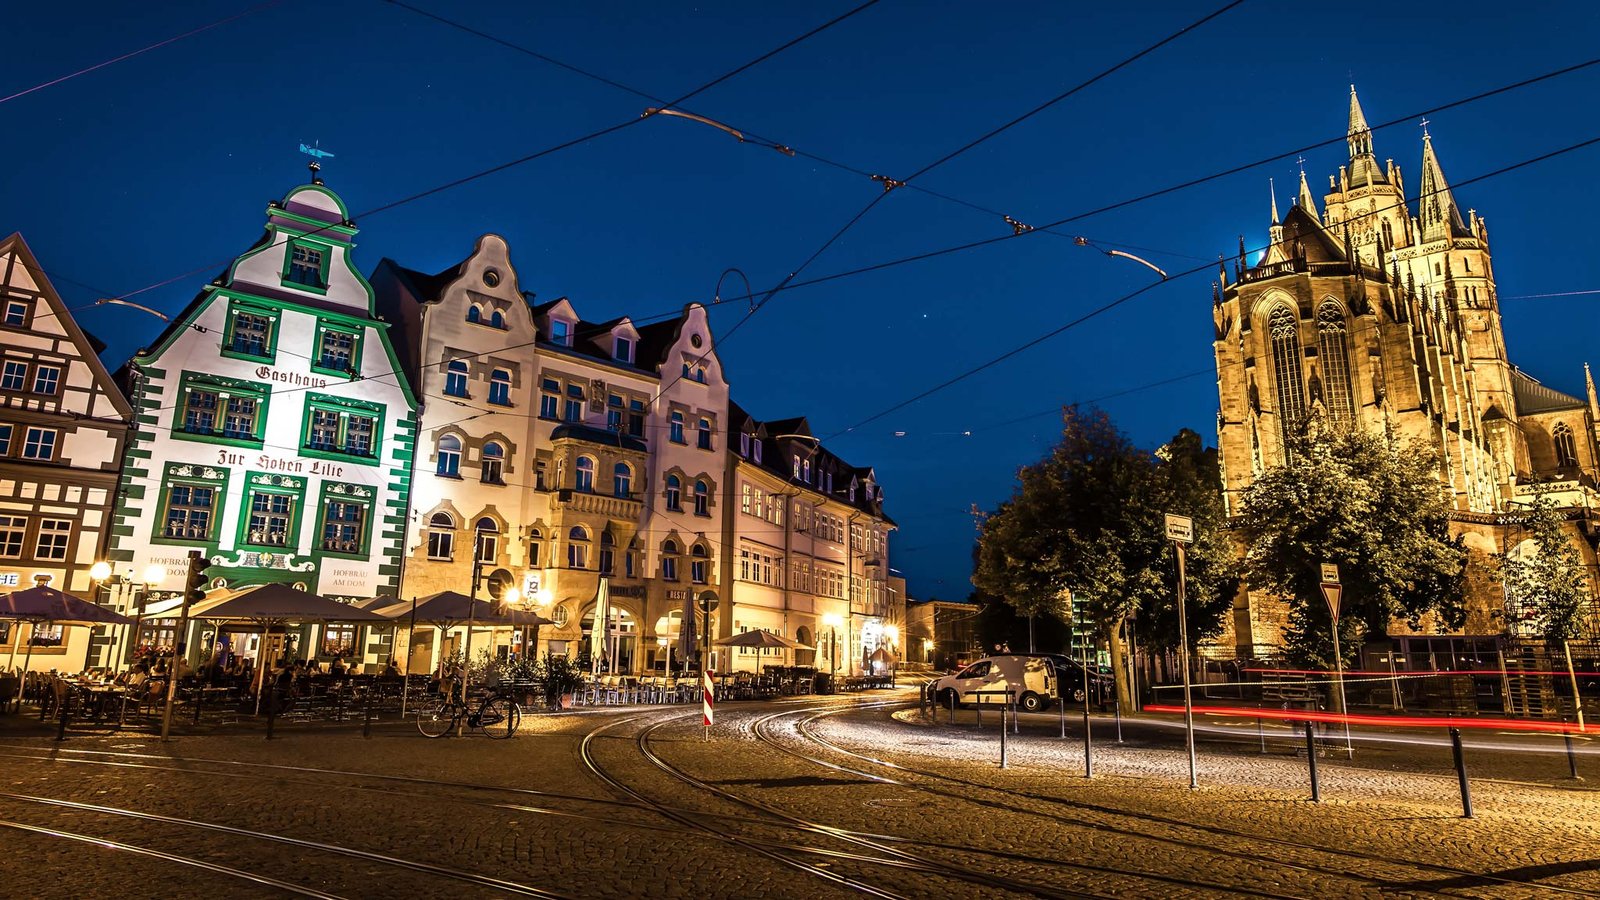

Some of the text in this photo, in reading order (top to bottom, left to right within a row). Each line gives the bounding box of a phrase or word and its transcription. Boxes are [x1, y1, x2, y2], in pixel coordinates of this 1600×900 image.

[255, 366, 327, 389] Gasthaus
[217, 449, 343, 478] Zur Hohen Lilie
